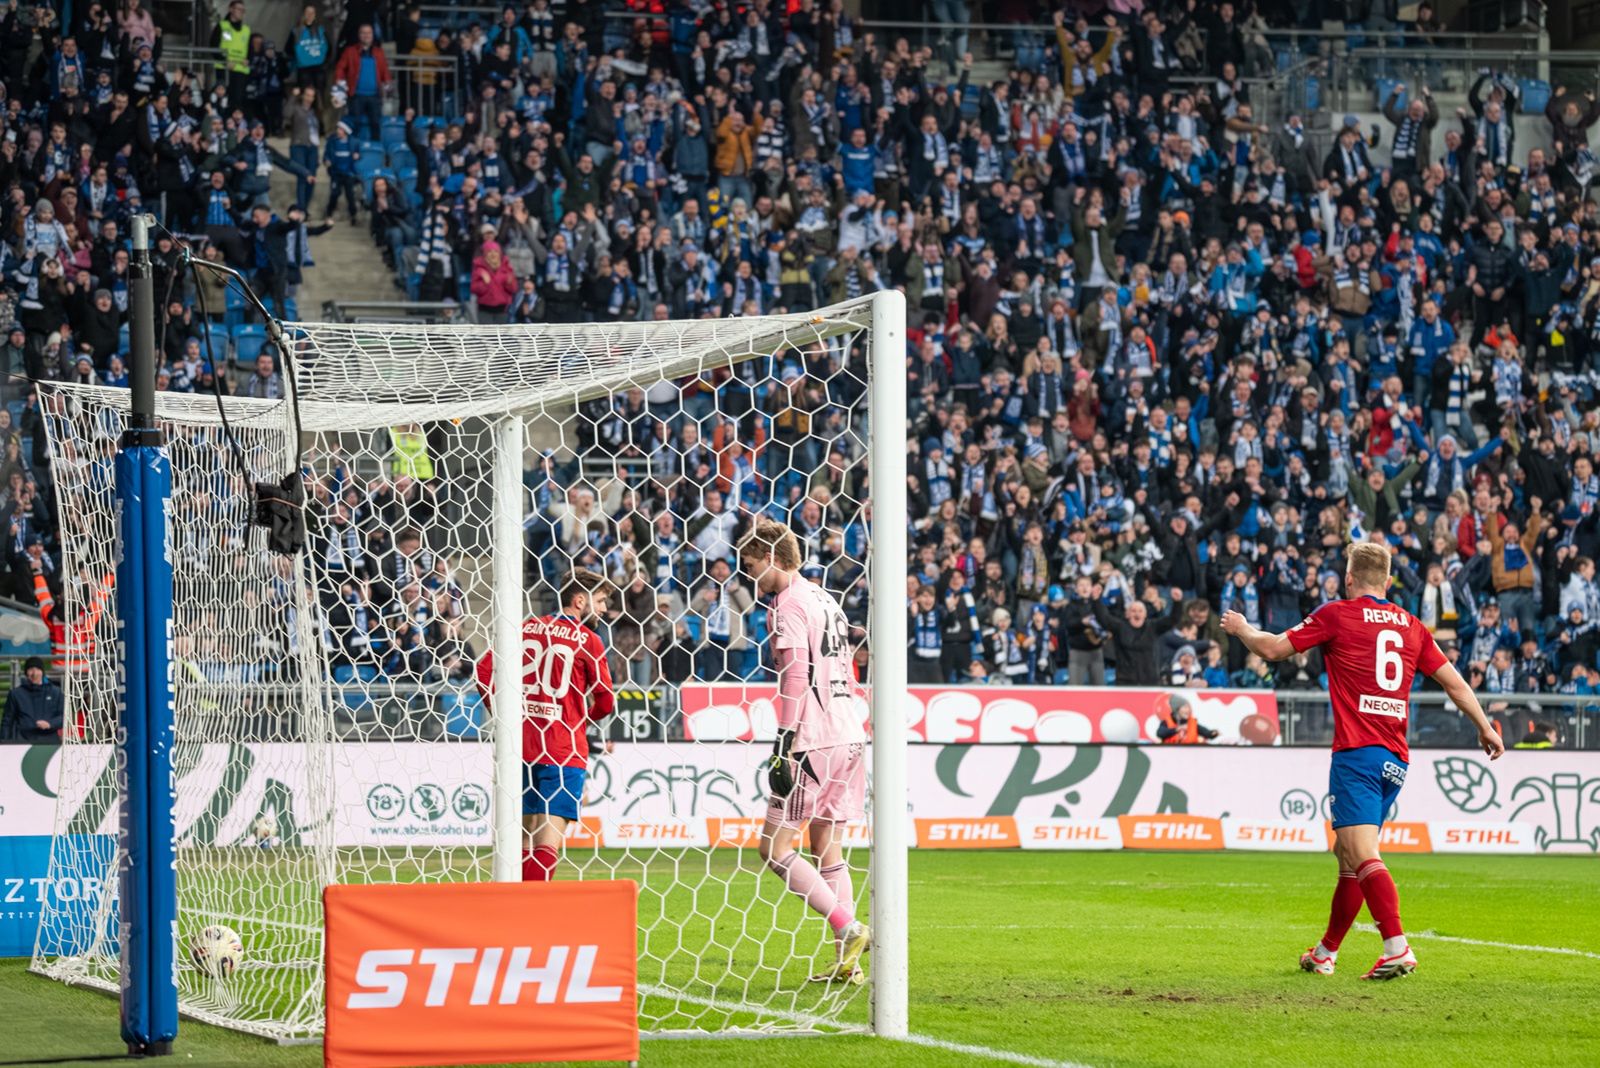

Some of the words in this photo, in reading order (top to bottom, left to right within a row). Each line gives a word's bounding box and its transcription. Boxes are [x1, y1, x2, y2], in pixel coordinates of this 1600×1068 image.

[1363, 608, 1410, 627] REPKA
[544, 625, 589, 645] CARLOS
[1375, 629, 1404, 691] 6
[522, 639, 574, 699] 20
[522, 702, 559, 716] EONET
[619, 710, 651, 739] 15
[1285, 799, 1312, 815] 18+
[617, 824, 695, 839] STIHL
[928, 823, 1008, 840] STIHL
[1033, 826, 1109, 840] STIHL
[1132, 822, 1213, 839] STIHL
[1237, 825, 1314, 843] STIHL
[1445, 829, 1520, 844] STIHL
[346, 945, 623, 1009] STIHL
